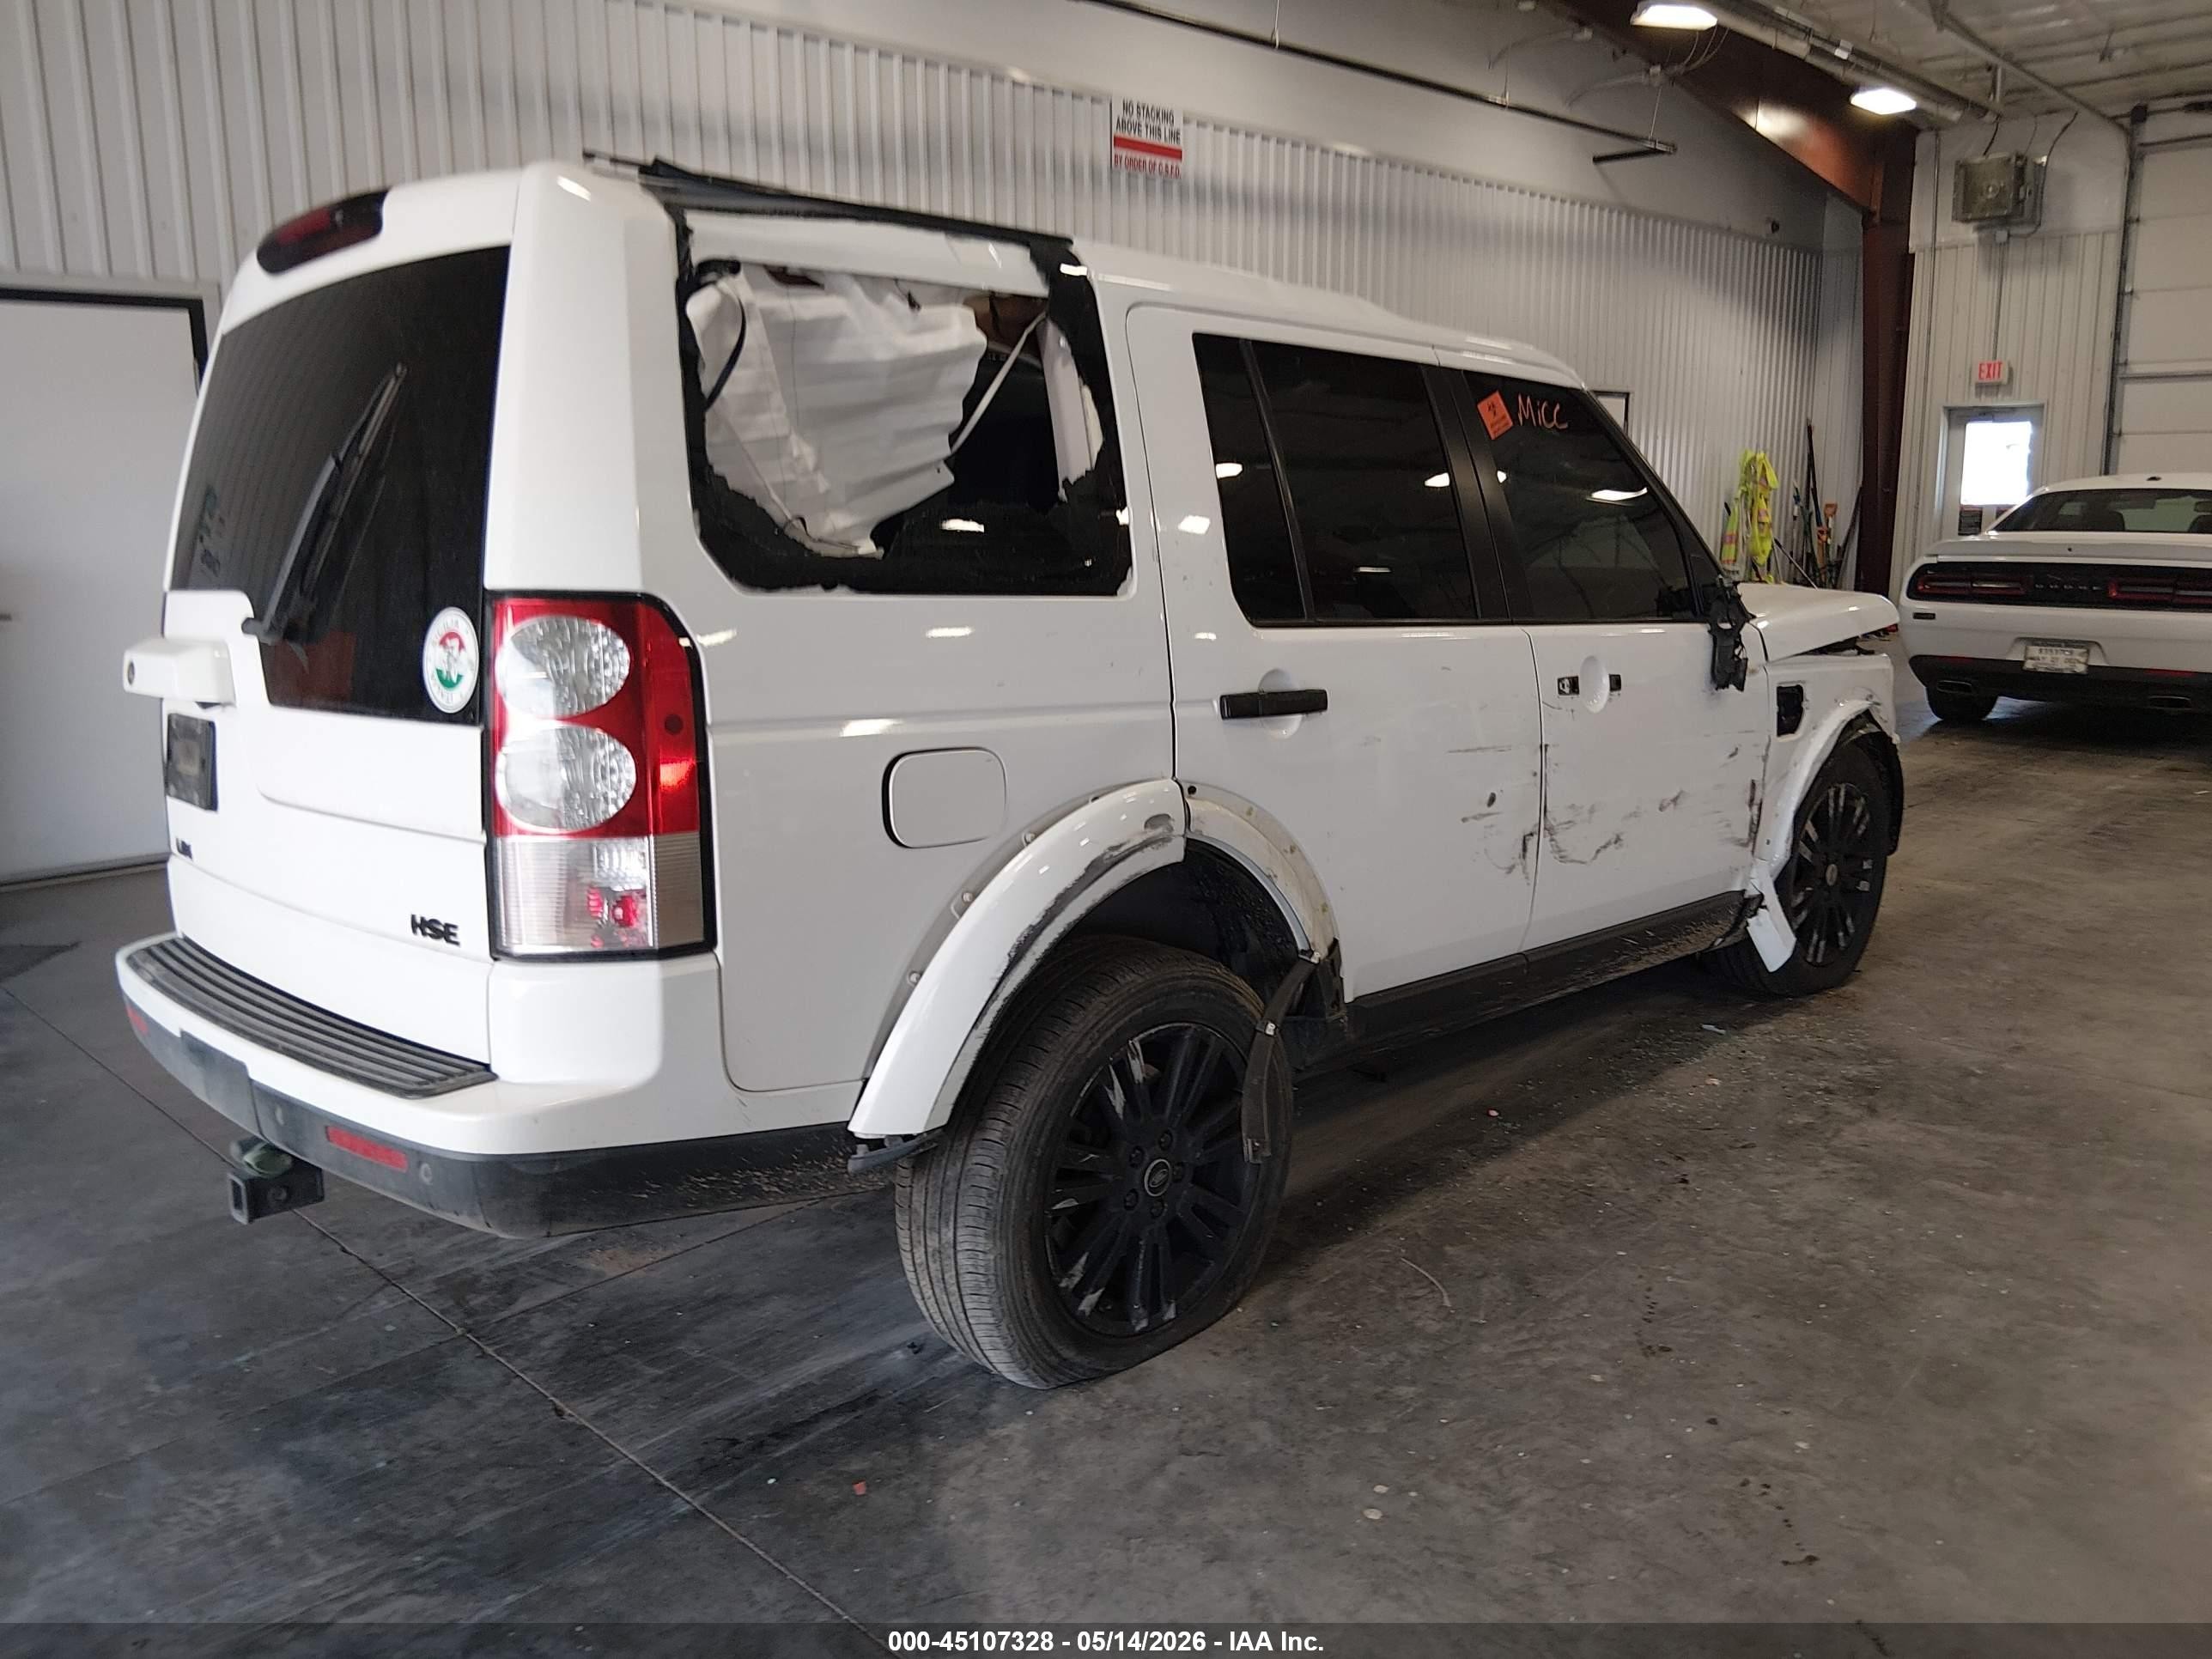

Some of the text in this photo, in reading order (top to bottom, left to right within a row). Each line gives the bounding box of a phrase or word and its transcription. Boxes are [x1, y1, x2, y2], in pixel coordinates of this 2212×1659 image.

[1122, 99, 1174, 126] NO STACKING
[1116, 116, 1181, 144] ABOVE THIS LINE
[1114, 155, 1123, 167] BY
[1124, 156, 1146, 173] ORDER
[1148, 160, 1158, 173] OF
[1978, 362, 2002, 380] EXIT
[411, 914, 460, 947] HSE
